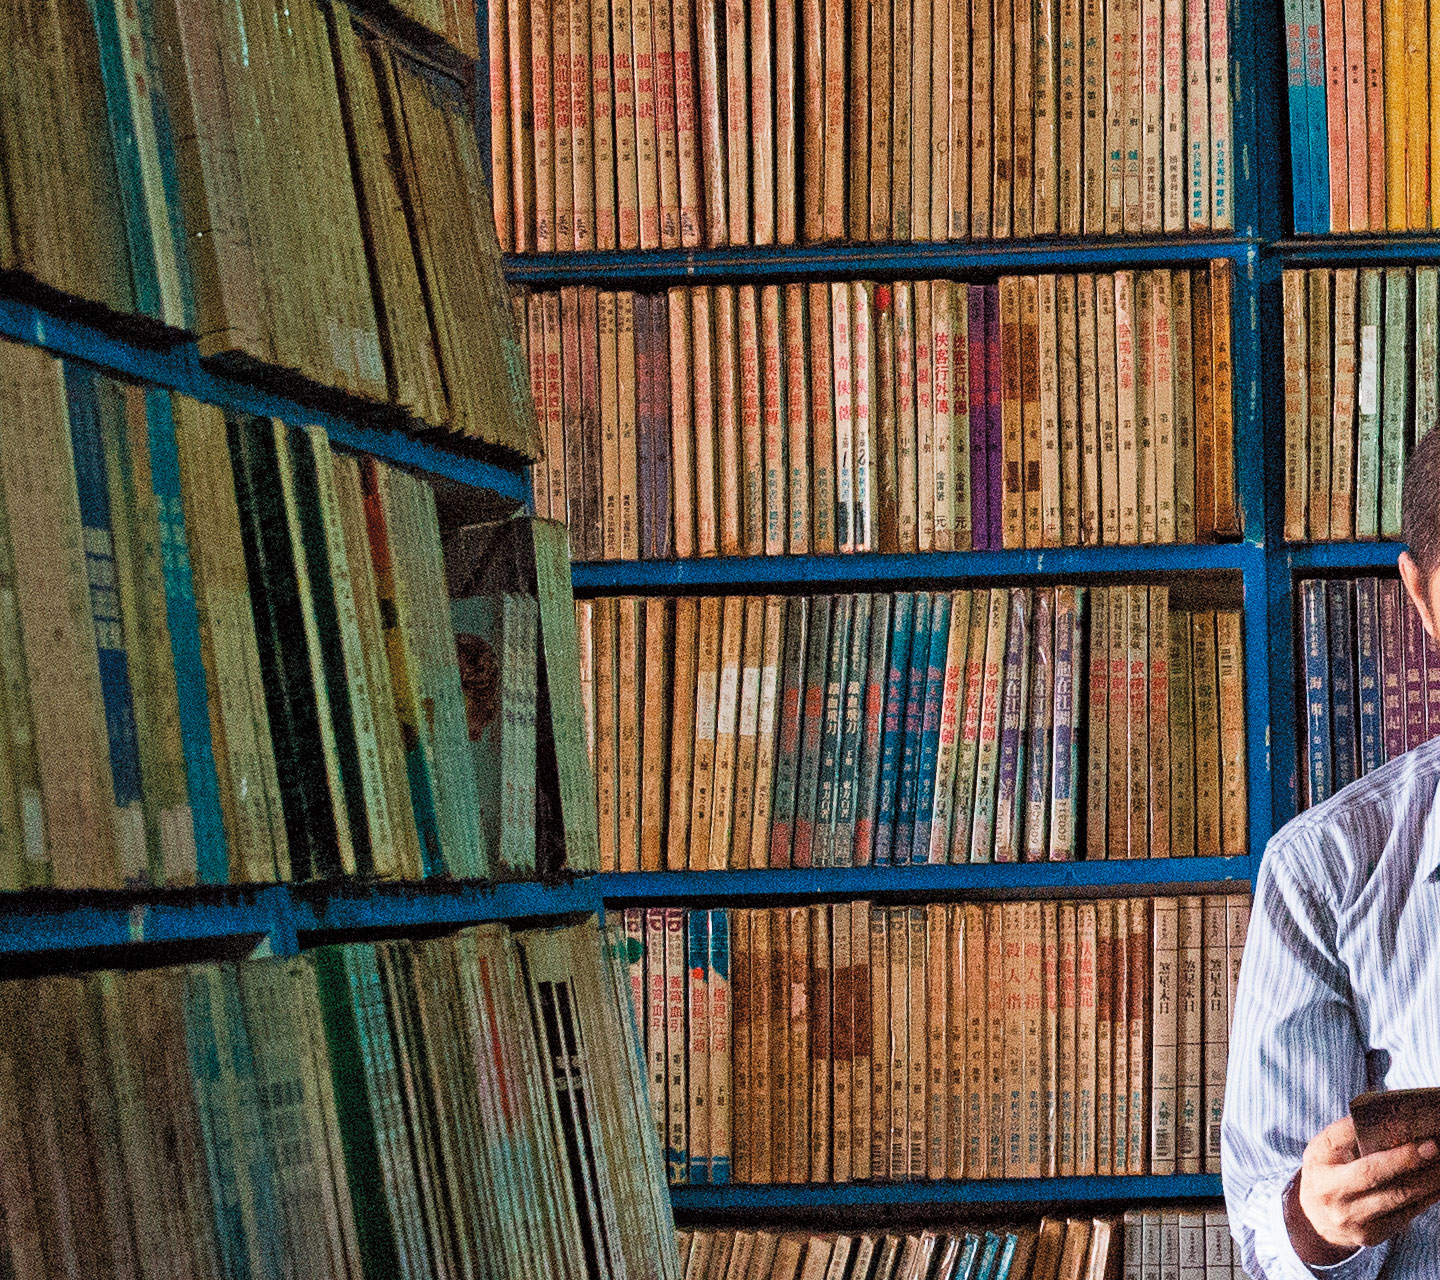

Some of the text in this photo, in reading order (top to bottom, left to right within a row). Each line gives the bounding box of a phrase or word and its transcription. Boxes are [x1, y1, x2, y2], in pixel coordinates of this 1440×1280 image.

[935, 332, 949, 416] 俠客行外傳
[953, 332, 968, 416] 俠客行外傳
